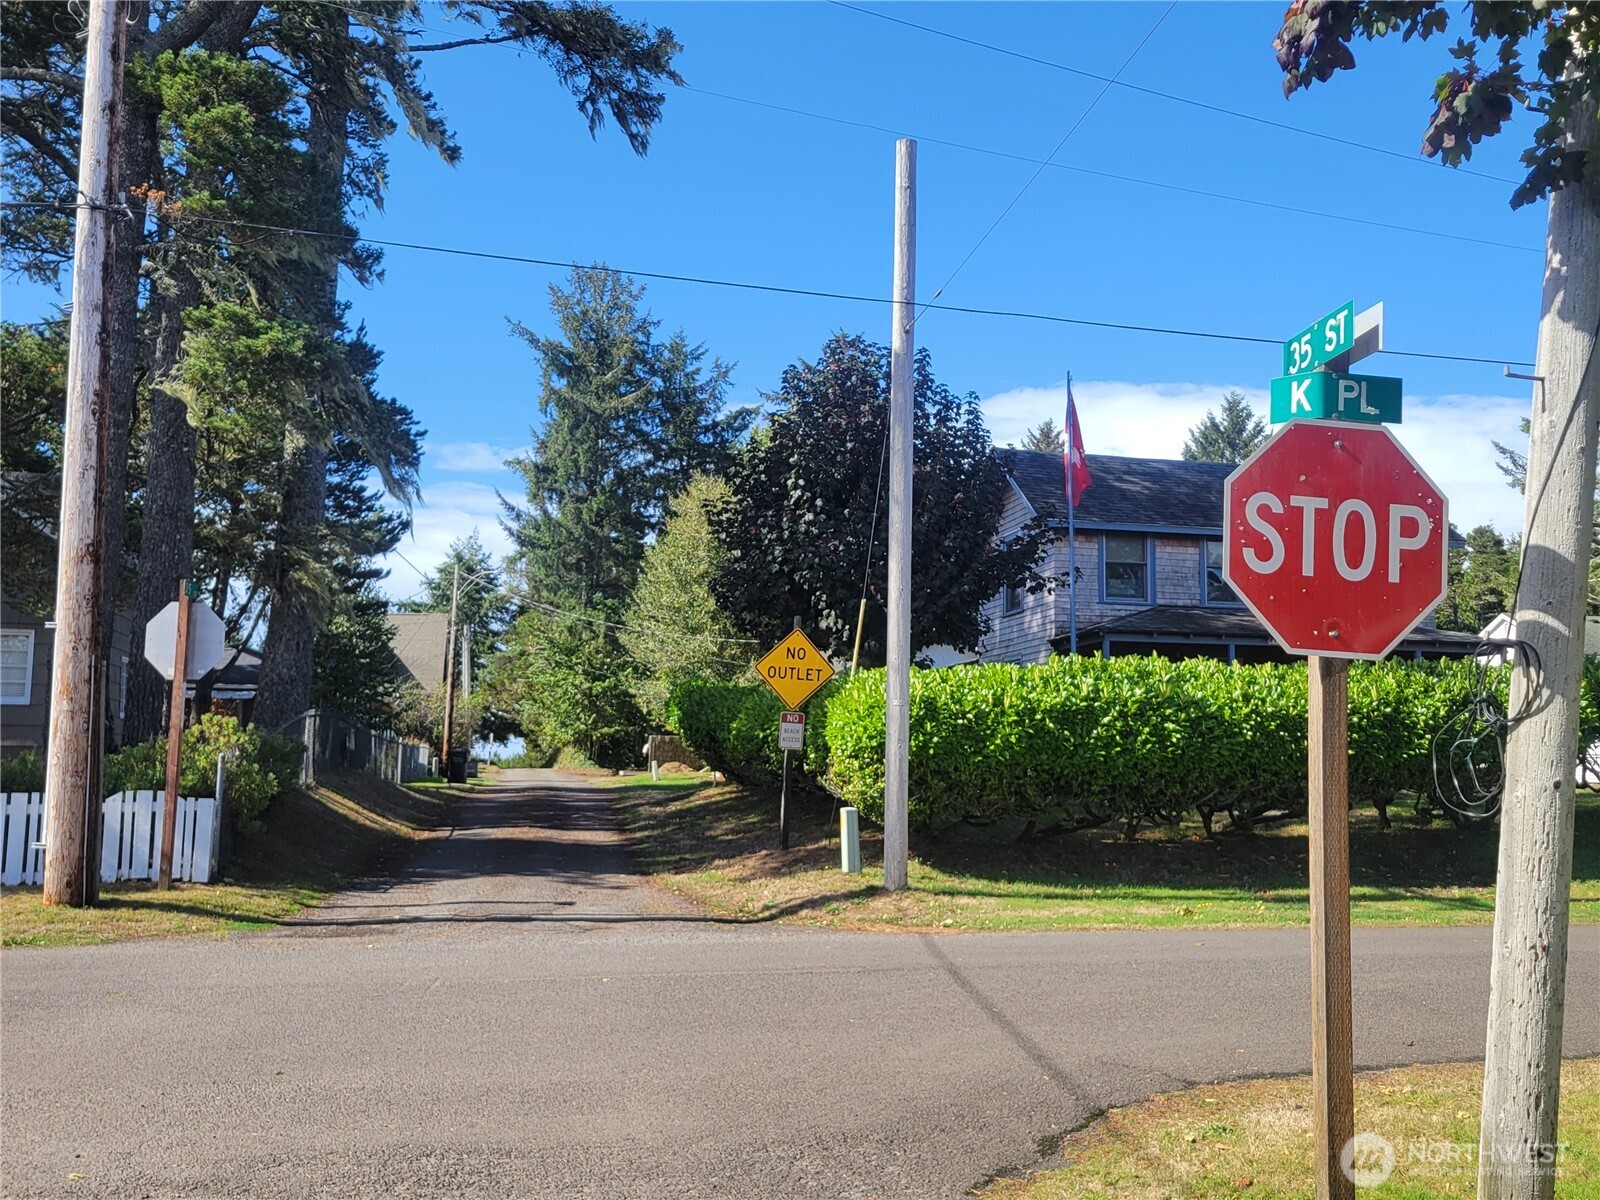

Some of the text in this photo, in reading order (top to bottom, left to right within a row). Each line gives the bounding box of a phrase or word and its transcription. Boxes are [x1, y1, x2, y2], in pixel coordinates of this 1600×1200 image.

[1288, 309, 1349, 374] 35 ST
[1290, 378, 1380, 414] K PL
[1242, 491, 1431, 583] STOP
[786, 647, 806, 660] NO
[767, 665, 823, 681] OUTLET
[786, 713, 800, 723] NO
